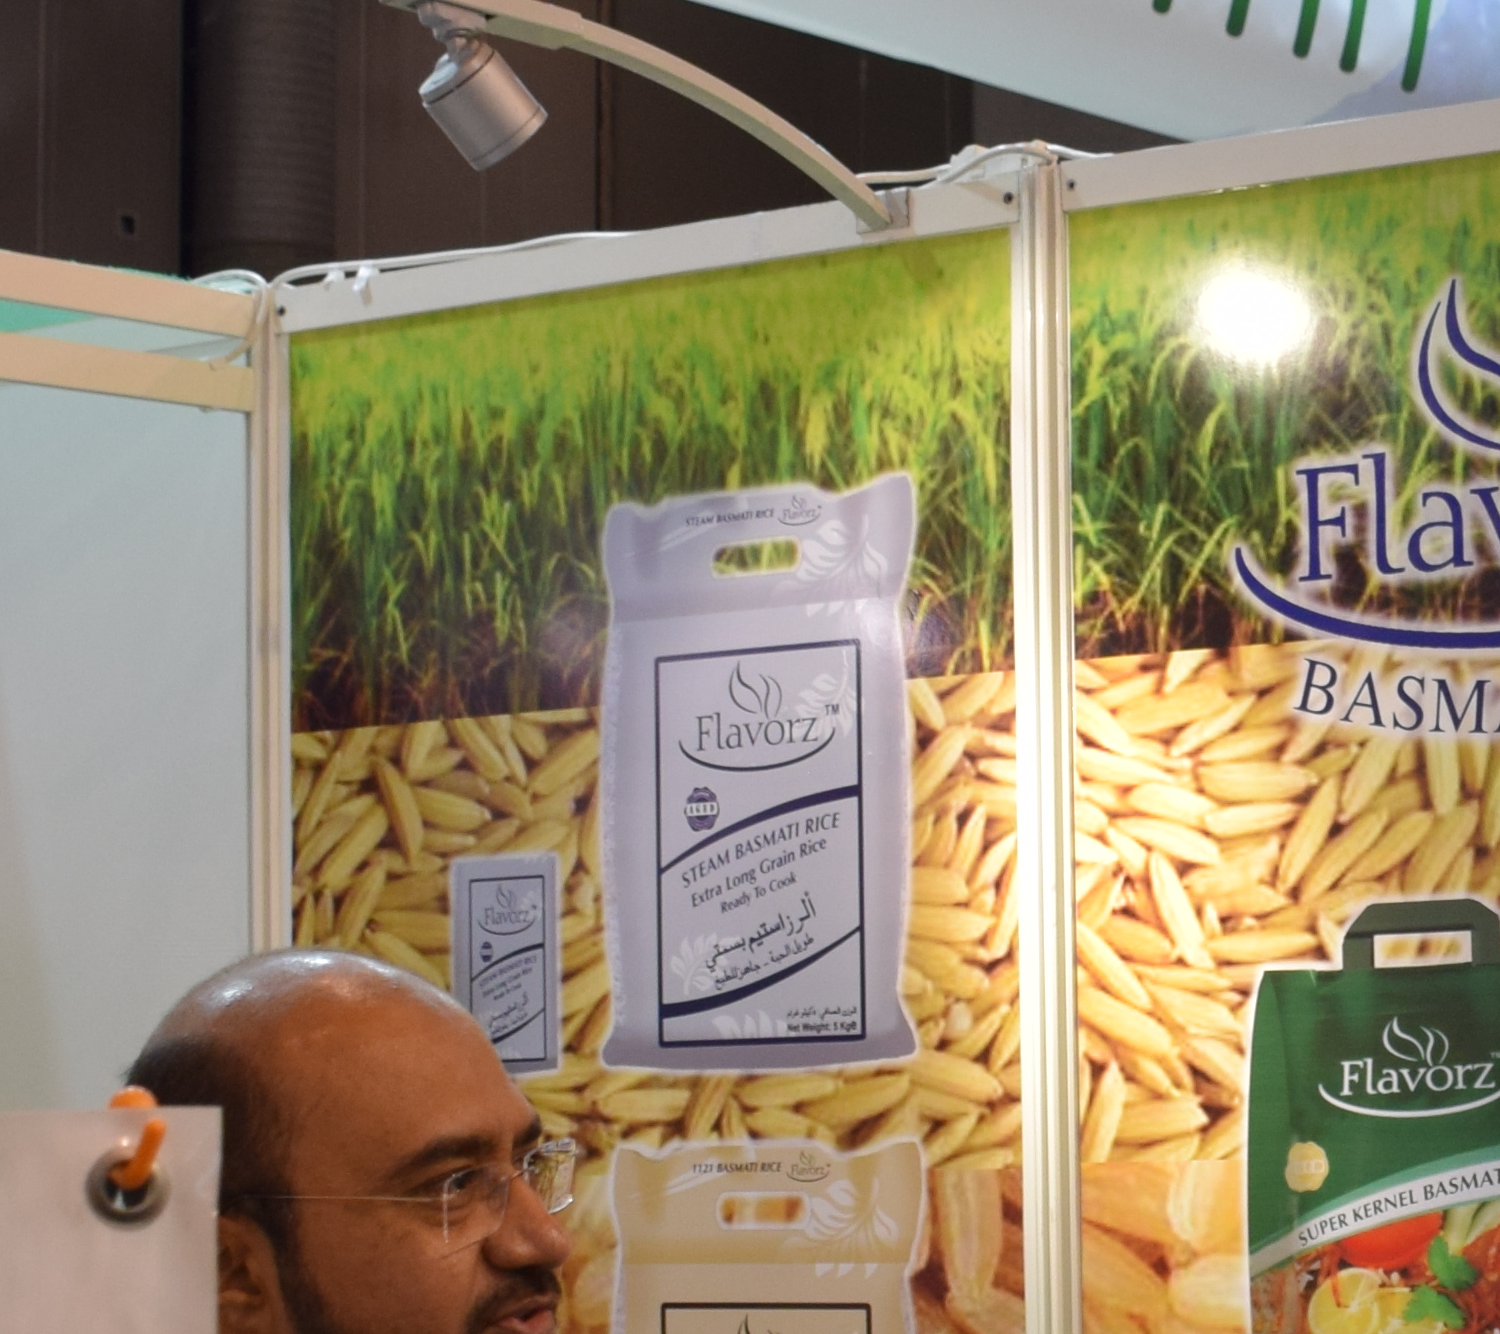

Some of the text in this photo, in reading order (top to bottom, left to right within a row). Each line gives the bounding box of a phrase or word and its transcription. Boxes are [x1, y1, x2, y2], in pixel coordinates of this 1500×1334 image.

[696, 712, 819, 751] Flavorz
[681, 812, 841, 888] STEAM BASMATI RICE
[691, 838, 828, 908] Extra Long Grain Rice
[754, 886, 767, 899] To
[768, 871, 798, 891] Cook
[1339, 1057, 1496, 1097] Flavorz
[1298, 1213, 1349, 1247] SUPER
[1353, 1189, 1419, 1223] KERNEL
